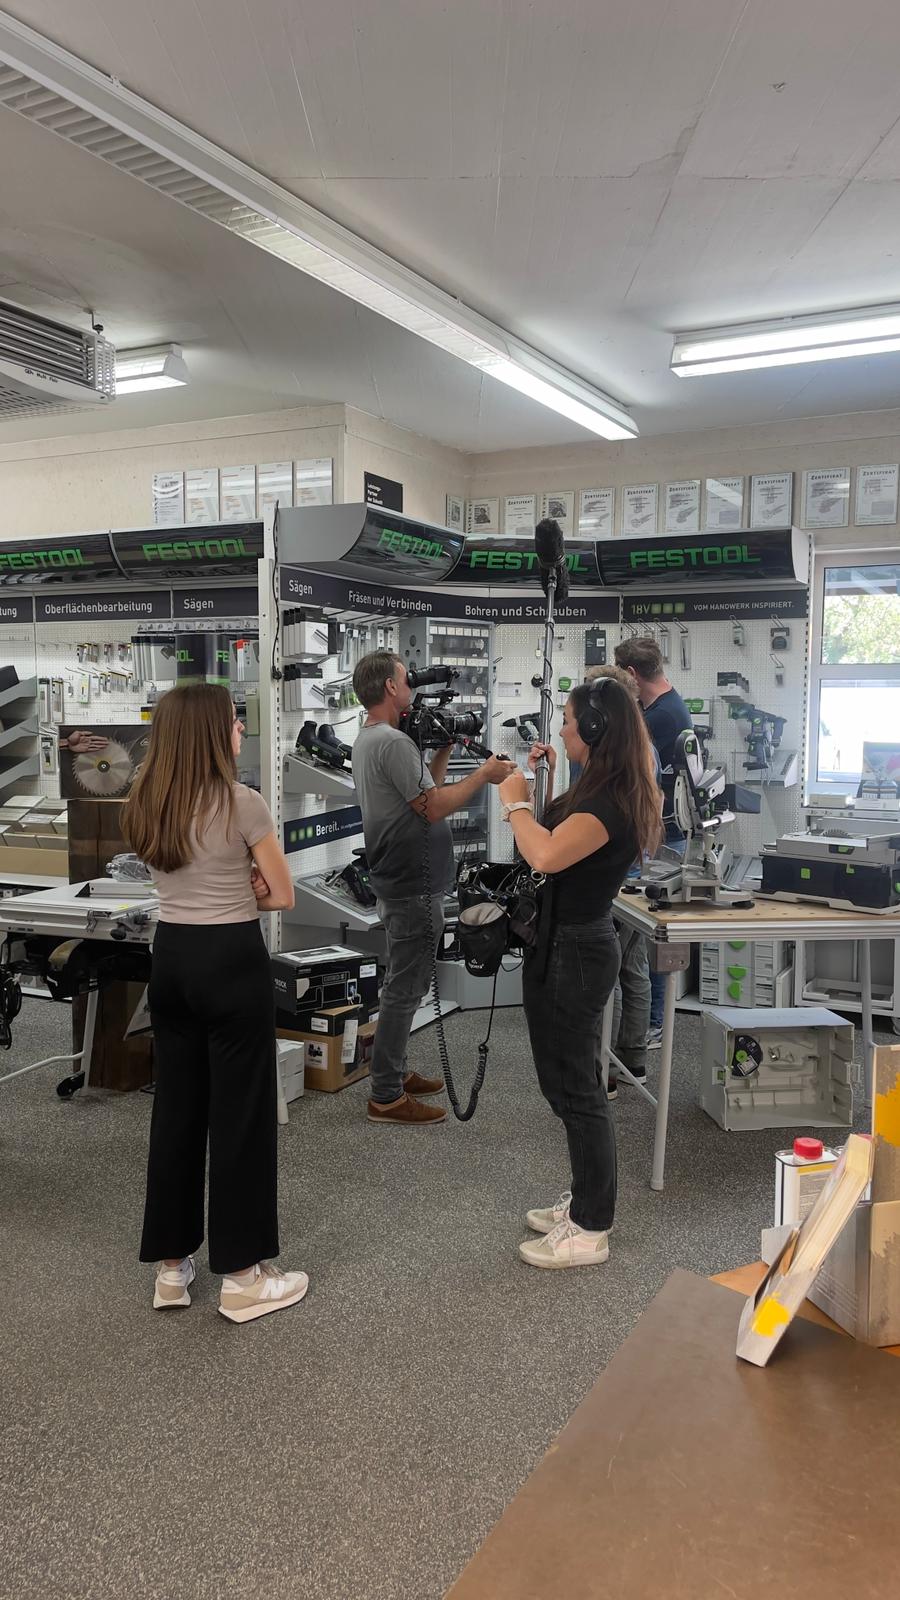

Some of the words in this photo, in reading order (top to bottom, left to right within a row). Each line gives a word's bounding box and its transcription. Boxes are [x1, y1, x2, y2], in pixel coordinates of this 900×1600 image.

[142, 538, 258, 562] FESTOOL
[377, 528, 444, 561] FESTOOL
[0, 548, 94, 571] FESTOOL
[630, 545, 761, 569] FESTOOL
[289, 579, 313, 596] Sägen
[44, 601, 153, 615] Oberflächenbearbeitung
[183, 598, 214, 611] Sägen
[348, 590, 372, 605] Fräsen
[372, 595, 385, 607] und
[386, 596, 433, 612] Verbinden
[630, 604, 650, 615] 18V
[709, 602, 750, 611] HANDWERK
[751, 601, 795, 609] INSPIRIERT.
[465, 605, 499, 617] Bohren
[501, 605, 523, 617] und
[316, 821, 340, 836] Bereit.
